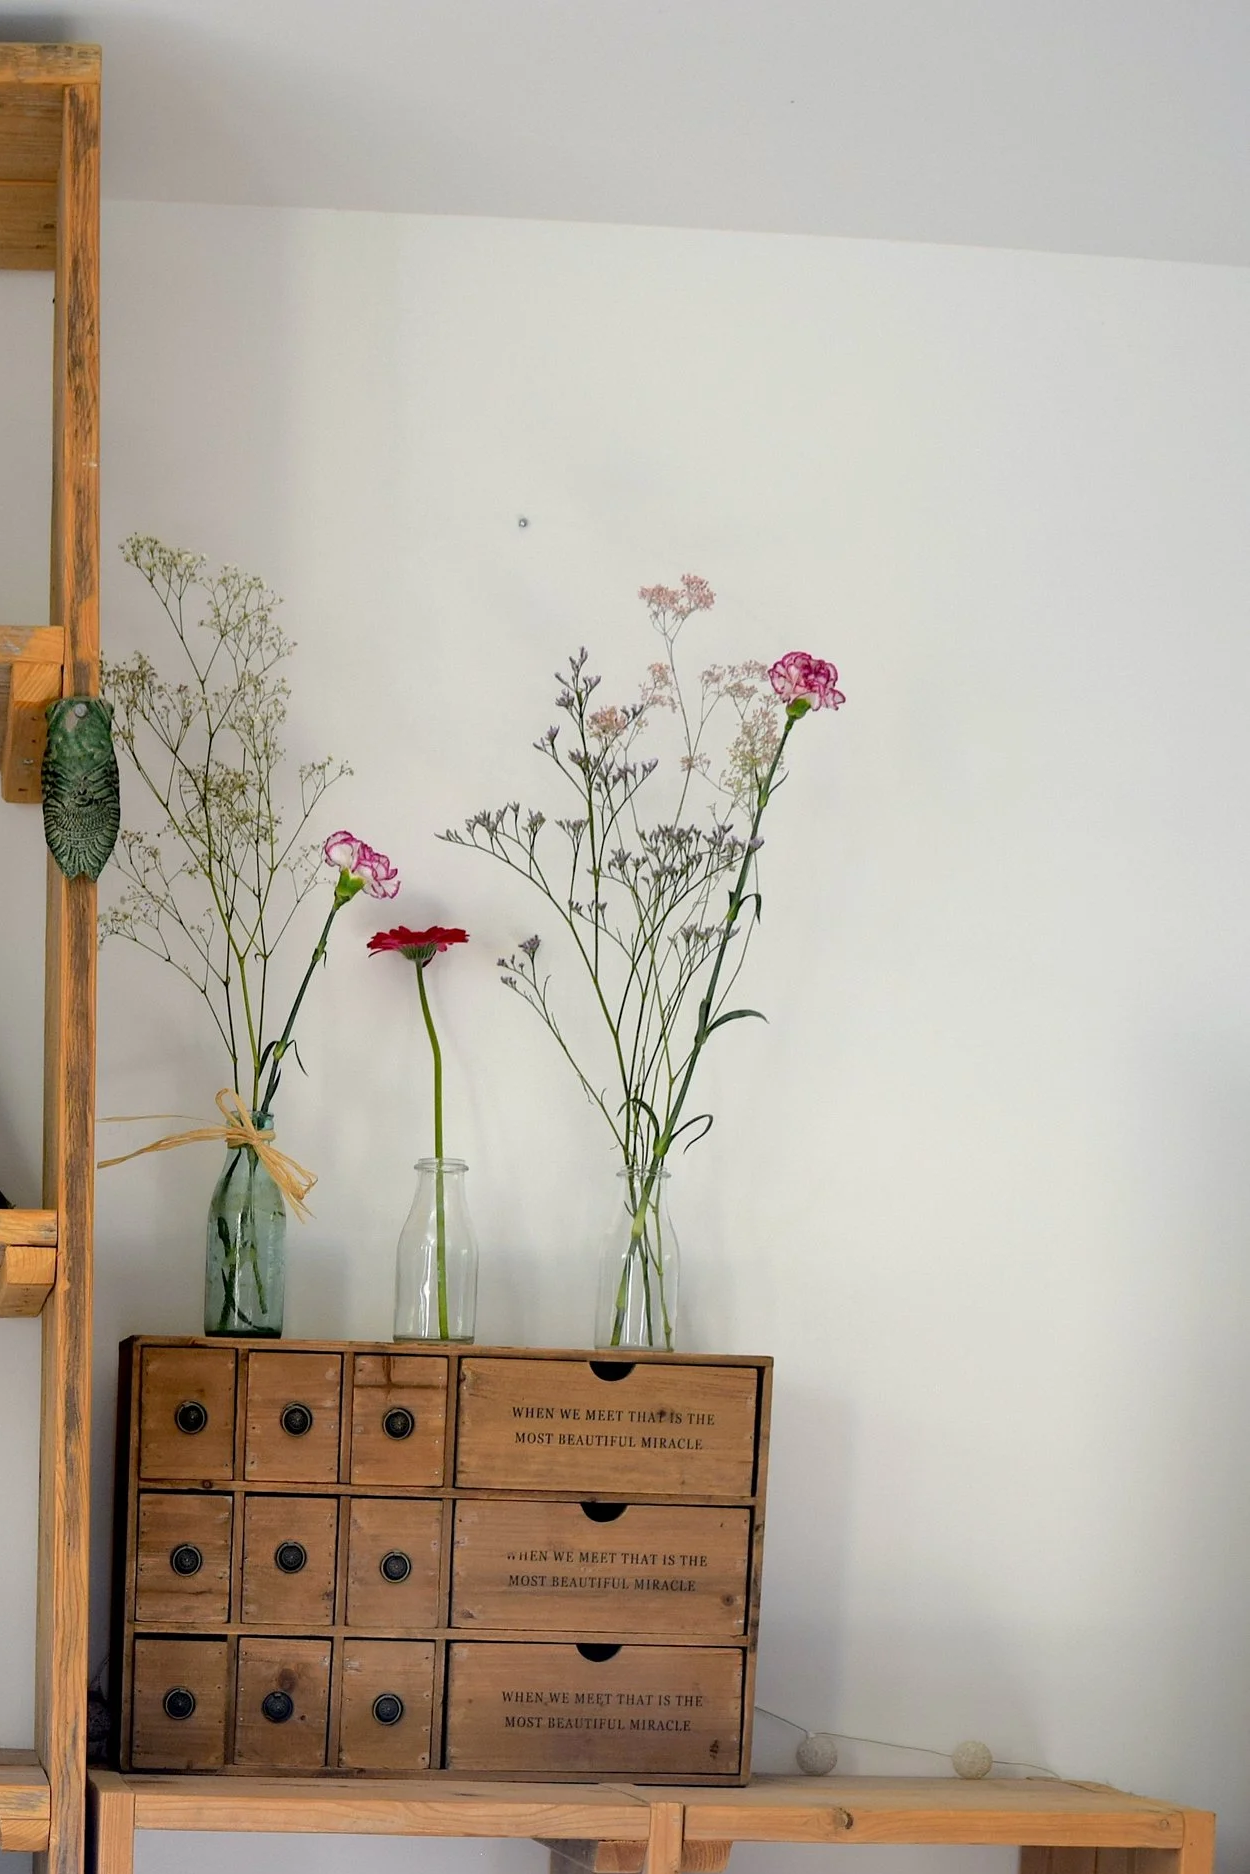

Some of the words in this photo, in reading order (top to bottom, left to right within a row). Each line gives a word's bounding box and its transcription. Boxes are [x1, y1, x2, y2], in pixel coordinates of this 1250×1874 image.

[512, 1406, 555, 1420] WHEN
[560, 1408, 581, 1421] WE
[586, 1409, 623, 1422] MEET
[629, 1410, 664, 1424] THAT
[670, 1412, 683, 1424] IS
[687, 1413, 716, 1426] THE
[515, 1431, 553, 1445] MOST
[558, 1433, 636, 1448] BEAUTIFUL
[641, 1436, 703, 1450] MIRACLE
[553, 1550, 574, 1563] WE
[579, 1552, 616, 1564] MEET
[621, 1552, 657, 1566] THAT
[663, 1554, 676, 1566] IS
[680, 1554, 708, 1567] THE
[508, 1574, 546, 1587] MOST
[552, 1576, 630, 1590] BEAUTIFUL
[634, 1579, 696, 1592] MIRACLE
[502, 1690, 543, 1704] WHEN
[549, 1691, 570, 1704] WE
[575, 1692, 611, 1705] MEET
[617, 1693, 653, 1706] THAT
[659, 1694, 671, 1706] IS
[675, 1695, 703, 1707] THE
[504, 1716, 543, 1728] MOST
[548, 1717, 625, 1731] BEAUTIFUL
[630, 1719, 691, 1732] MIRACLE
